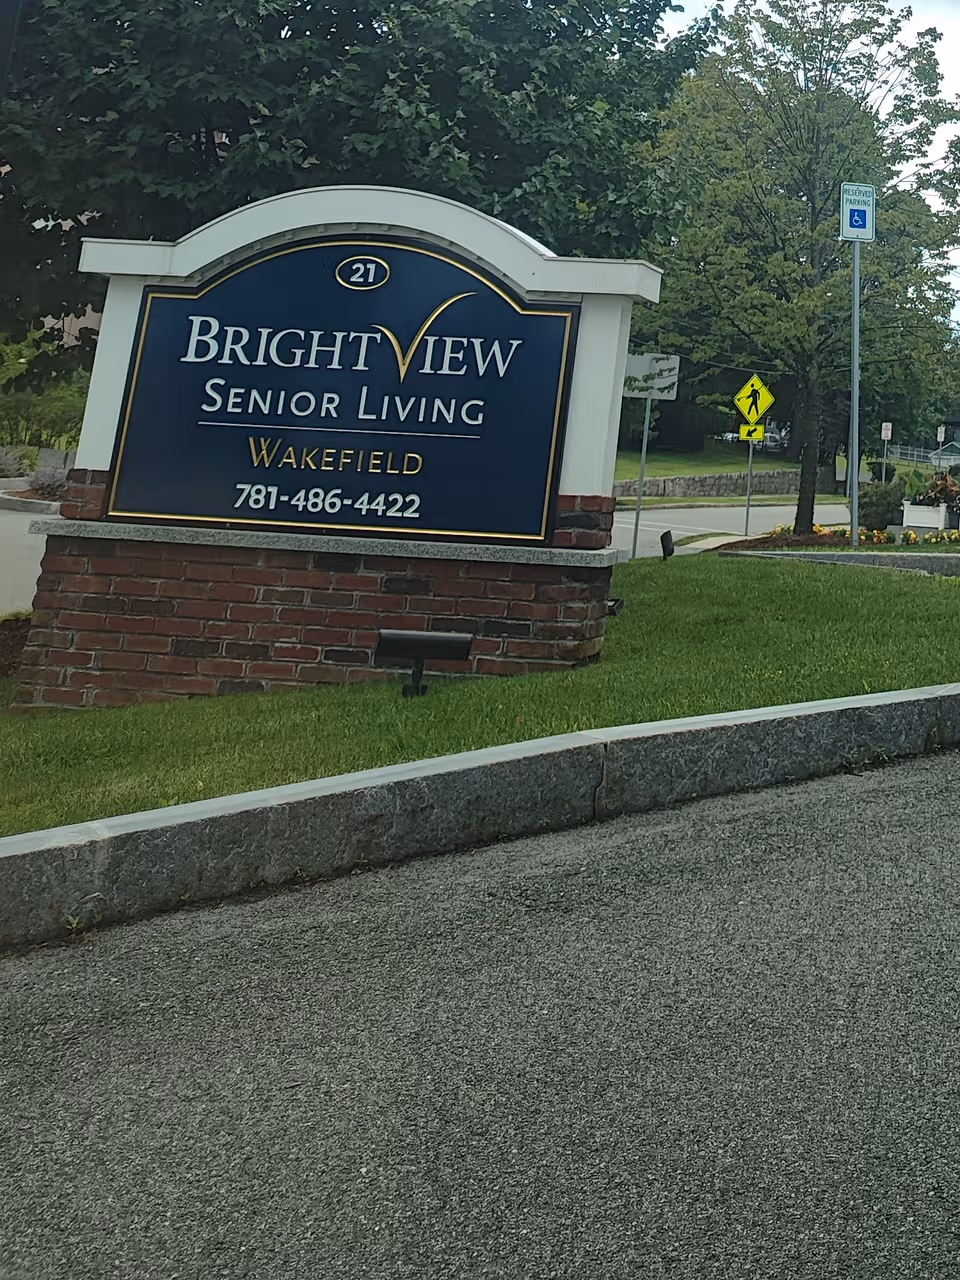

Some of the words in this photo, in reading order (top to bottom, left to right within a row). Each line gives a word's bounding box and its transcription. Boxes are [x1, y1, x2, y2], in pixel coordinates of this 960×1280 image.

[844, 188, 872, 197] RESERVED
[845, 198, 871, 207] PARKING
[348, 262, 376, 284] 21
[180, 291, 523, 383] BRIGHTVIEW
[200, 377, 341, 420] SENIOR
[358, 385, 486, 425] LIVING
[248, 436, 424, 475] WAKEFIELD
[233, 483, 421, 519] 781-486-4422
